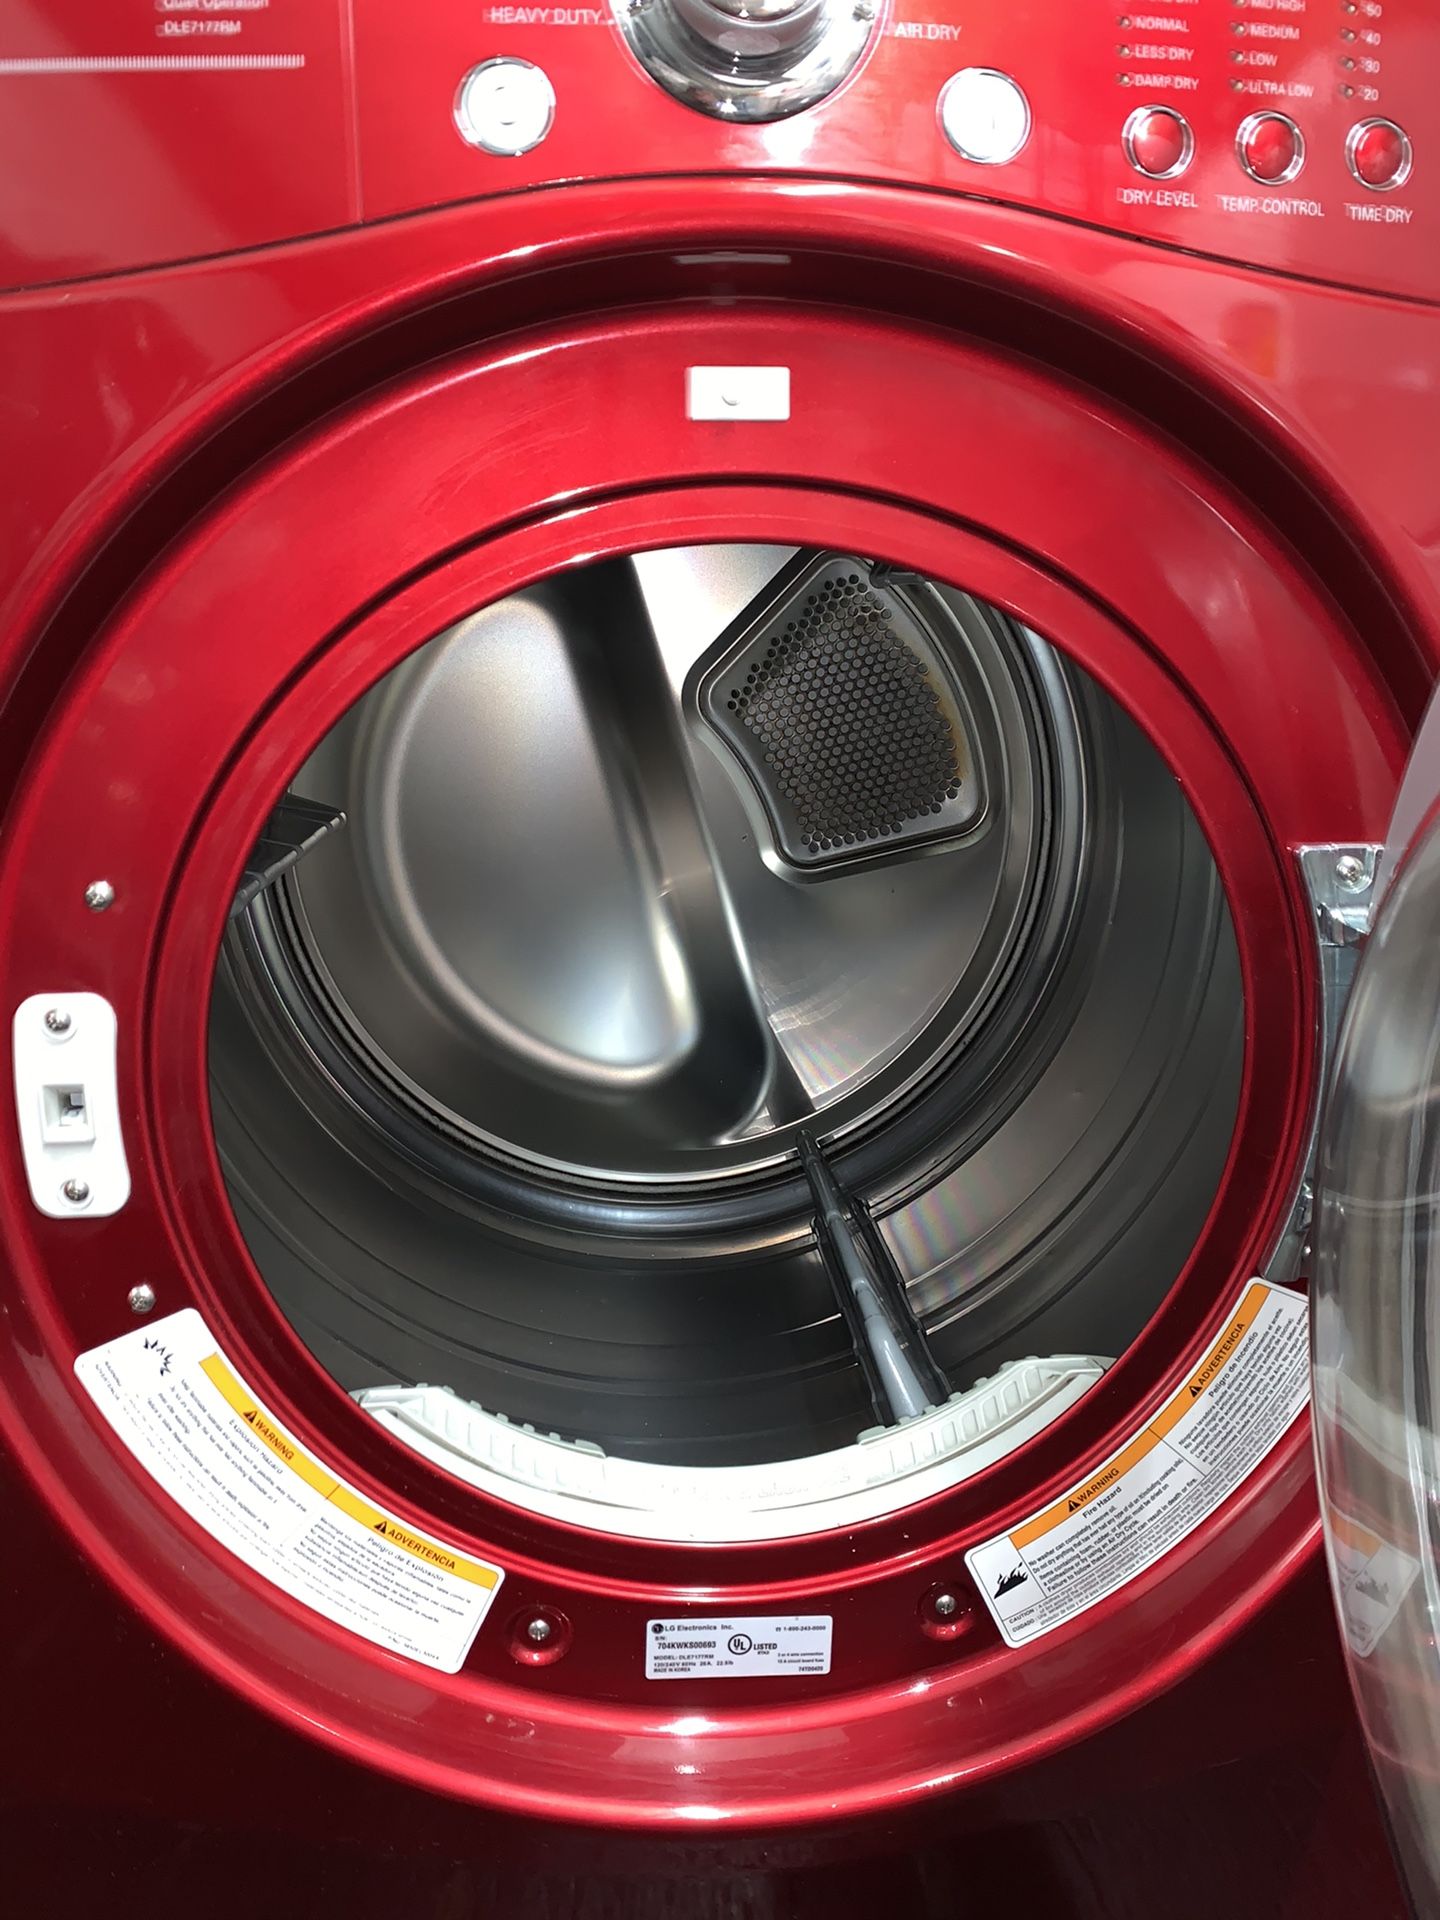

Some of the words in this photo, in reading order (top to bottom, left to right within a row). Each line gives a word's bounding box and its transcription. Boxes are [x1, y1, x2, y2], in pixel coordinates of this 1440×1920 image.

[490, 6, 549, 23] HEAVY
[553, 8, 602, 25] DUTY
[1135, 16, 1190, 32] NORMAL
[894, 22, 923, 38] AIR
[926, 23, 961, 41] DRY
[1251, 24, 1300, 40] MEDIUM
[1364, 32, 1381, 46] 40
[1135, 45, 1166, 60] LESS
[1168, 47, 1194, 61] DRY
[1250, 52, 1278, 66] LOW
[1365, 60, 1380, 73] 30
[1135, 74, 1171, 88] DAMP
[1174, 77, 1199, 90] DRY
[1250, 80, 1285, 96] ULTRA
[1287, 83, 1314, 97] LOW
[1364, 88, 1379, 101] 20
[1123, 188, 1152, 205] DRY
[1156, 189, 1198, 208] LEVEL
[1262, 198, 1325, 217] CONTROL
[1350, 205, 1381, 222] TIME
[1385, 208, 1413, 224] DRY
[1197, 1321, 1245, 1385] ADVERTENCIA
[1208, 1371, 1231, 1398] Peligro
[1227, 1361, 1237, 1372] de
[1234, 1330, 1258, 1362] Incendio
[253, 1418, 295, 1460] WARNING
[1076, 1466, 1119, 1503] WARNING
[1081, 1504, 1097, 1518] Fire
[1096, 1485, 1122, 1507] Hazard
[1115, 1513, 1133, 1529] plastic
[1131, 1503, 1144, 1516] must
[1149, 1488, 1163, 1501] dried
[1039, 1561, 1048, 1569] not
[1047, 1557, 1055, 1565] dry
[1054, 1545, 1074, 1561] anything
[1072, 1540, 1082, 1548] that
[1081, 1534, 1090, 1542] has
[1089, 1528, 1099, 1537] ever
[1097, 1522, 1107, 1531] had
[1106, 1517, 1116, 1526] any
[1113, 1509, 1125, 1520] type
[1047, 1577, 1067, 1592] Failure
[1073, 1562, 1091, 1575] follow
[1090, 1551, 1106, 1564] these
[1105, 1528, 1137, 1554] instructions
[1136, 1521, 1147, 1531] can
[1146, 1508, 1162, 1523] result
[1166, 1490, 1182, 1506] death
[1055, 1542, 1065, 1550] can
[1064, 1524, 1091, 1545] completely
[1086, 1546, 1102, 1560] using
[1107, 1535, 1115, 1544] Air
[1114, 1529, 1125, 1539] Dry
[387, 1527, 457, 1569] ADVERTENCIA
[1008, 1607, 1034, 1624] CAUTION
[1011, 1617, 1035, 1632] CUIDADO
[677, 1624, 717, 1632] Electronics
